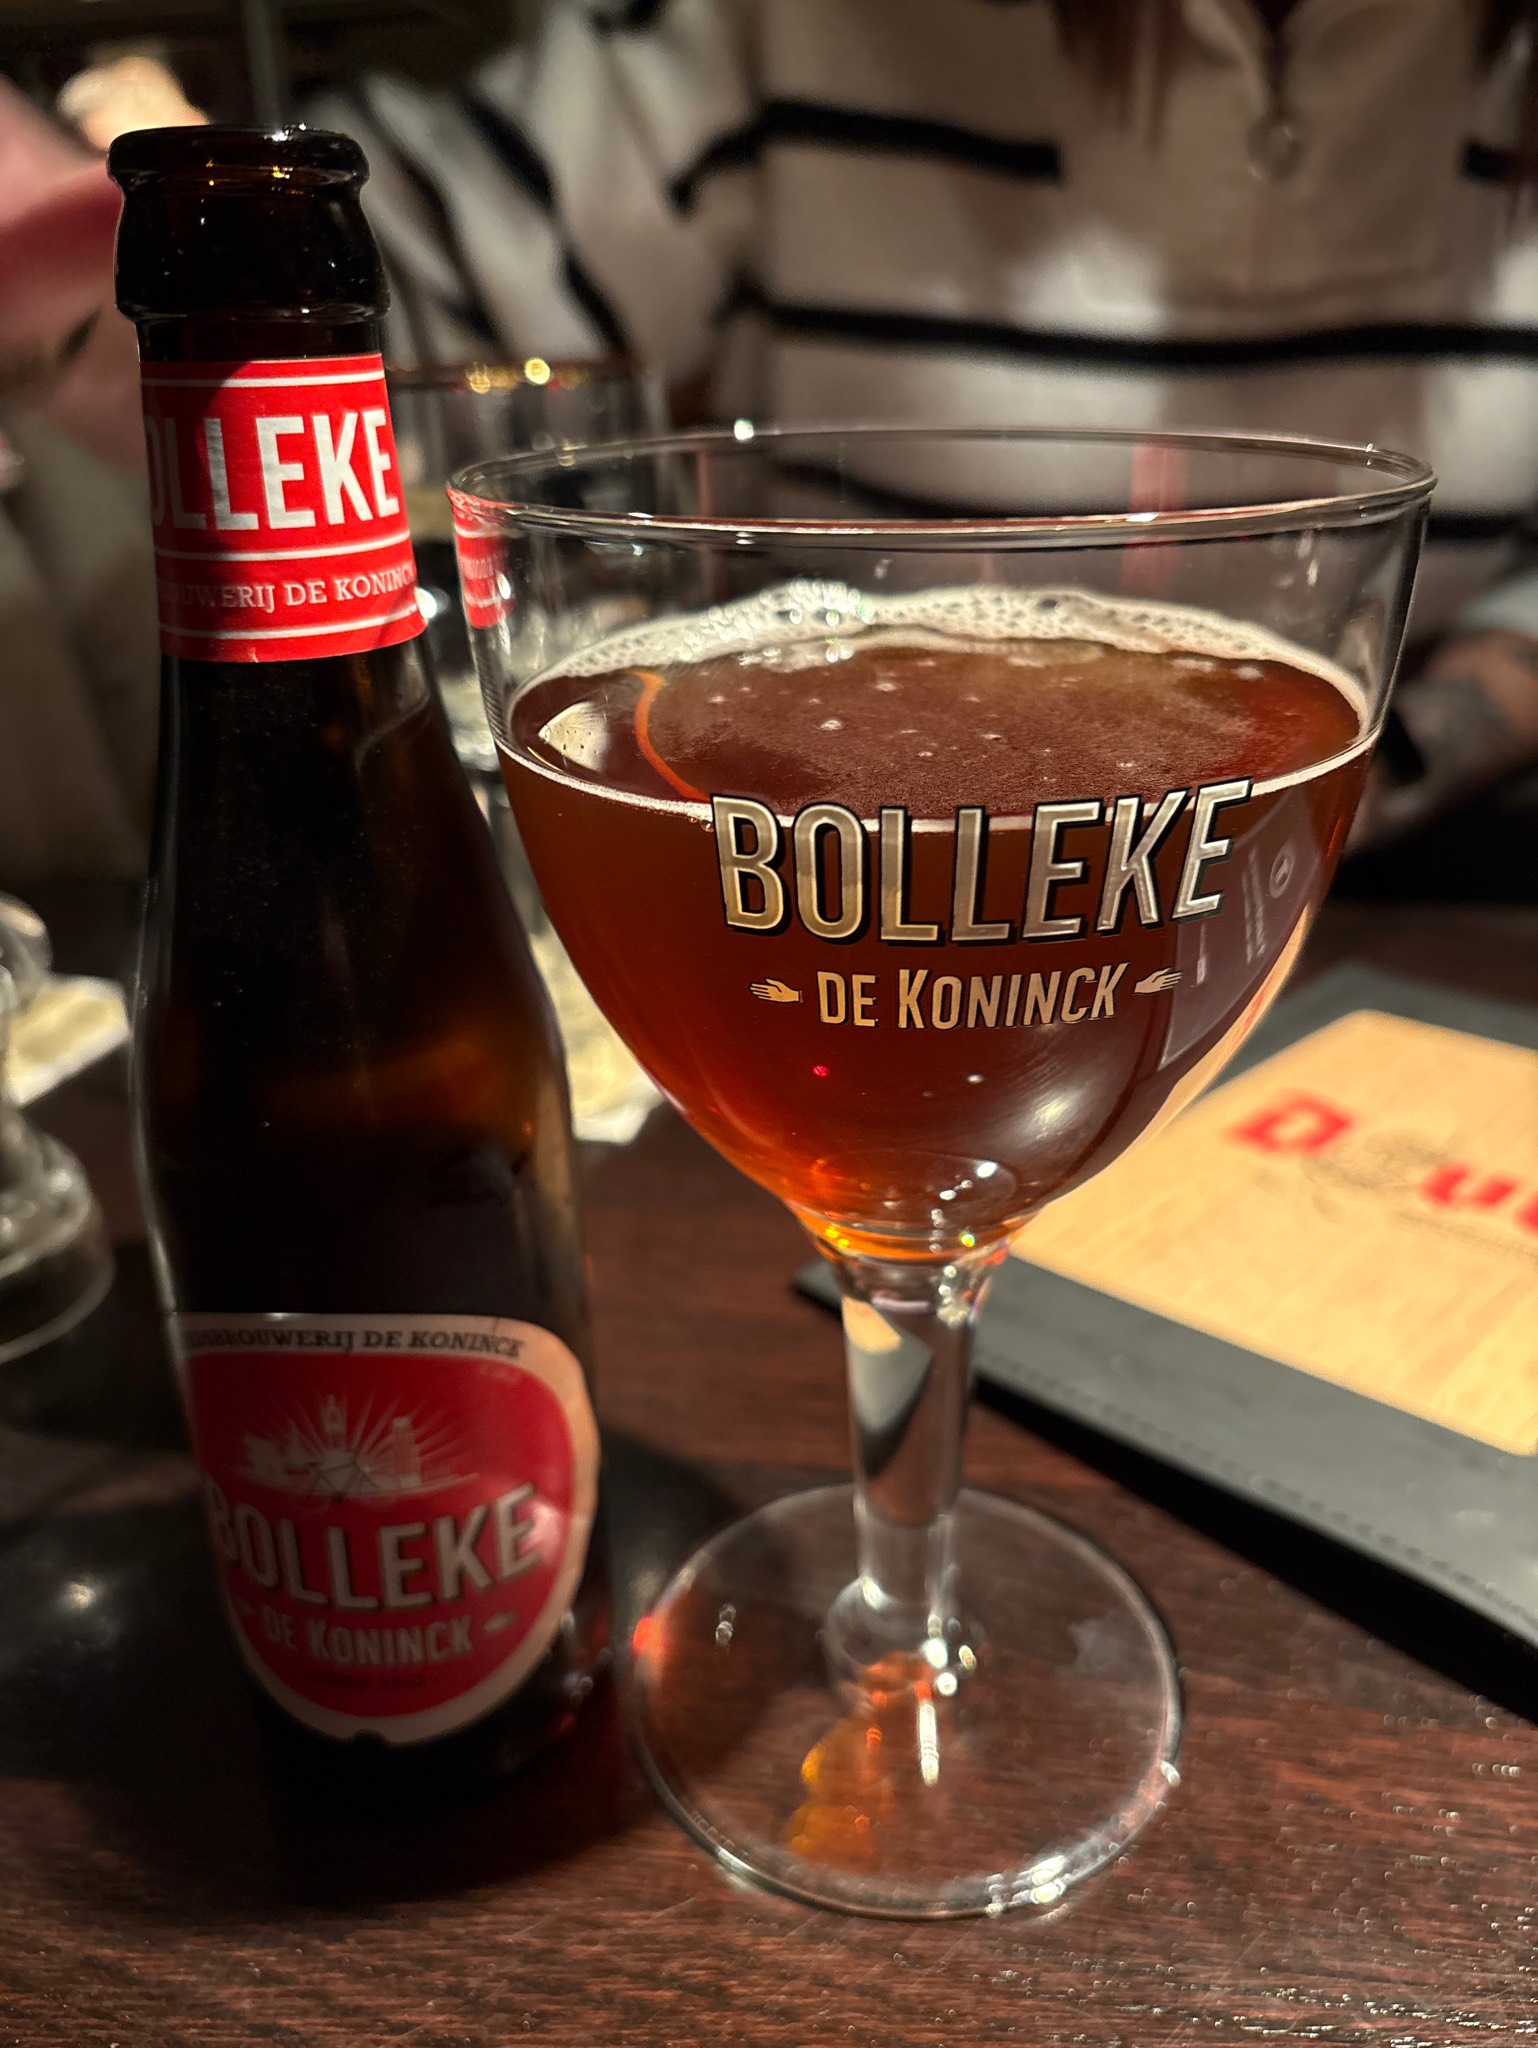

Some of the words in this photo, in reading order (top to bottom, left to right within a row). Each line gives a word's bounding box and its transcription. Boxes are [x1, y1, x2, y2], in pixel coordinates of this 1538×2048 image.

[284, 580, 327, 607] DE
[711, 777, 1253, 945] BOLLEKE
[816, 970, 878, 1028] DE
[898, 962, 1131, 1030] KONINCK
[363, 1330, 402, 1348] DE
[408, 1330, 525, 1359] KONINCK
[205, 1476, 542, 1611] BOLLEKE
[263, 1603, 298, 1650] DE
[306, 1614, 475, 1665] KONINCK
